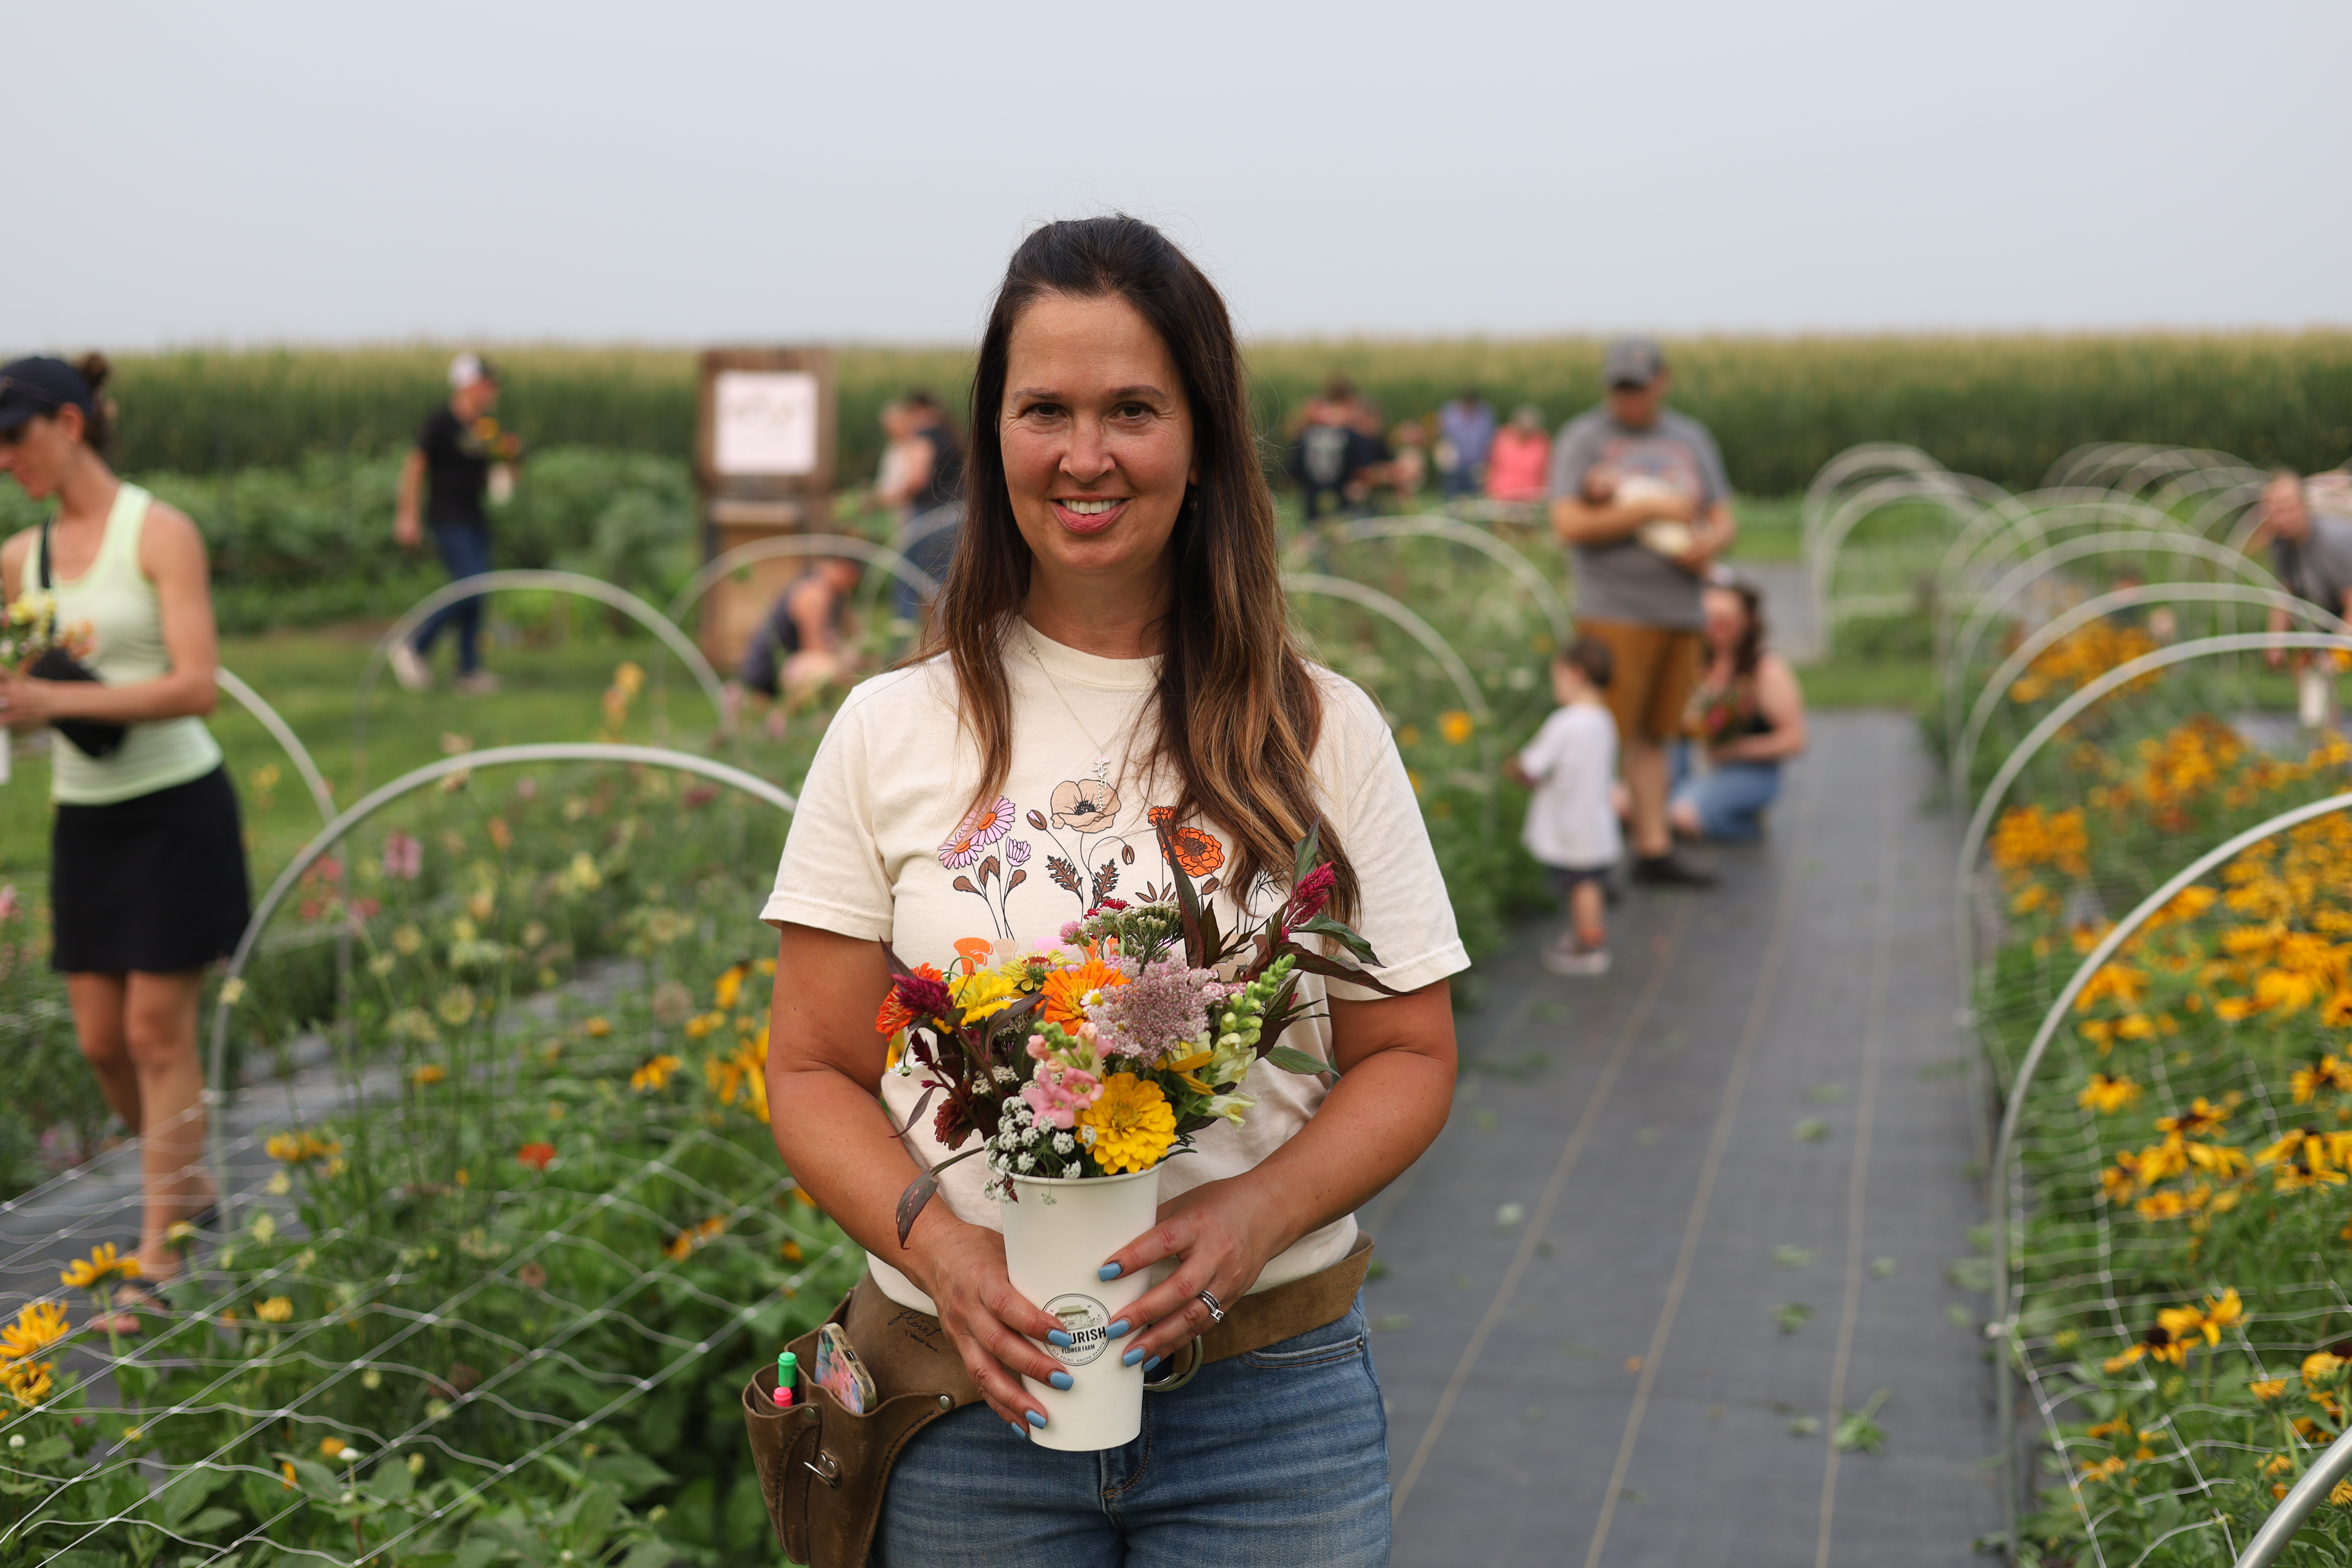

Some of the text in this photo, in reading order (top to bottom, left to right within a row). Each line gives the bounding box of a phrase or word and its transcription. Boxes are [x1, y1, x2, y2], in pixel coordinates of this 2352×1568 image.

[1067, 1326, 1107, 1344] URISH
[1082, 1343, 1095, 1352] FARM
[1093, 1341, 1105, 1356] DAKOTA
